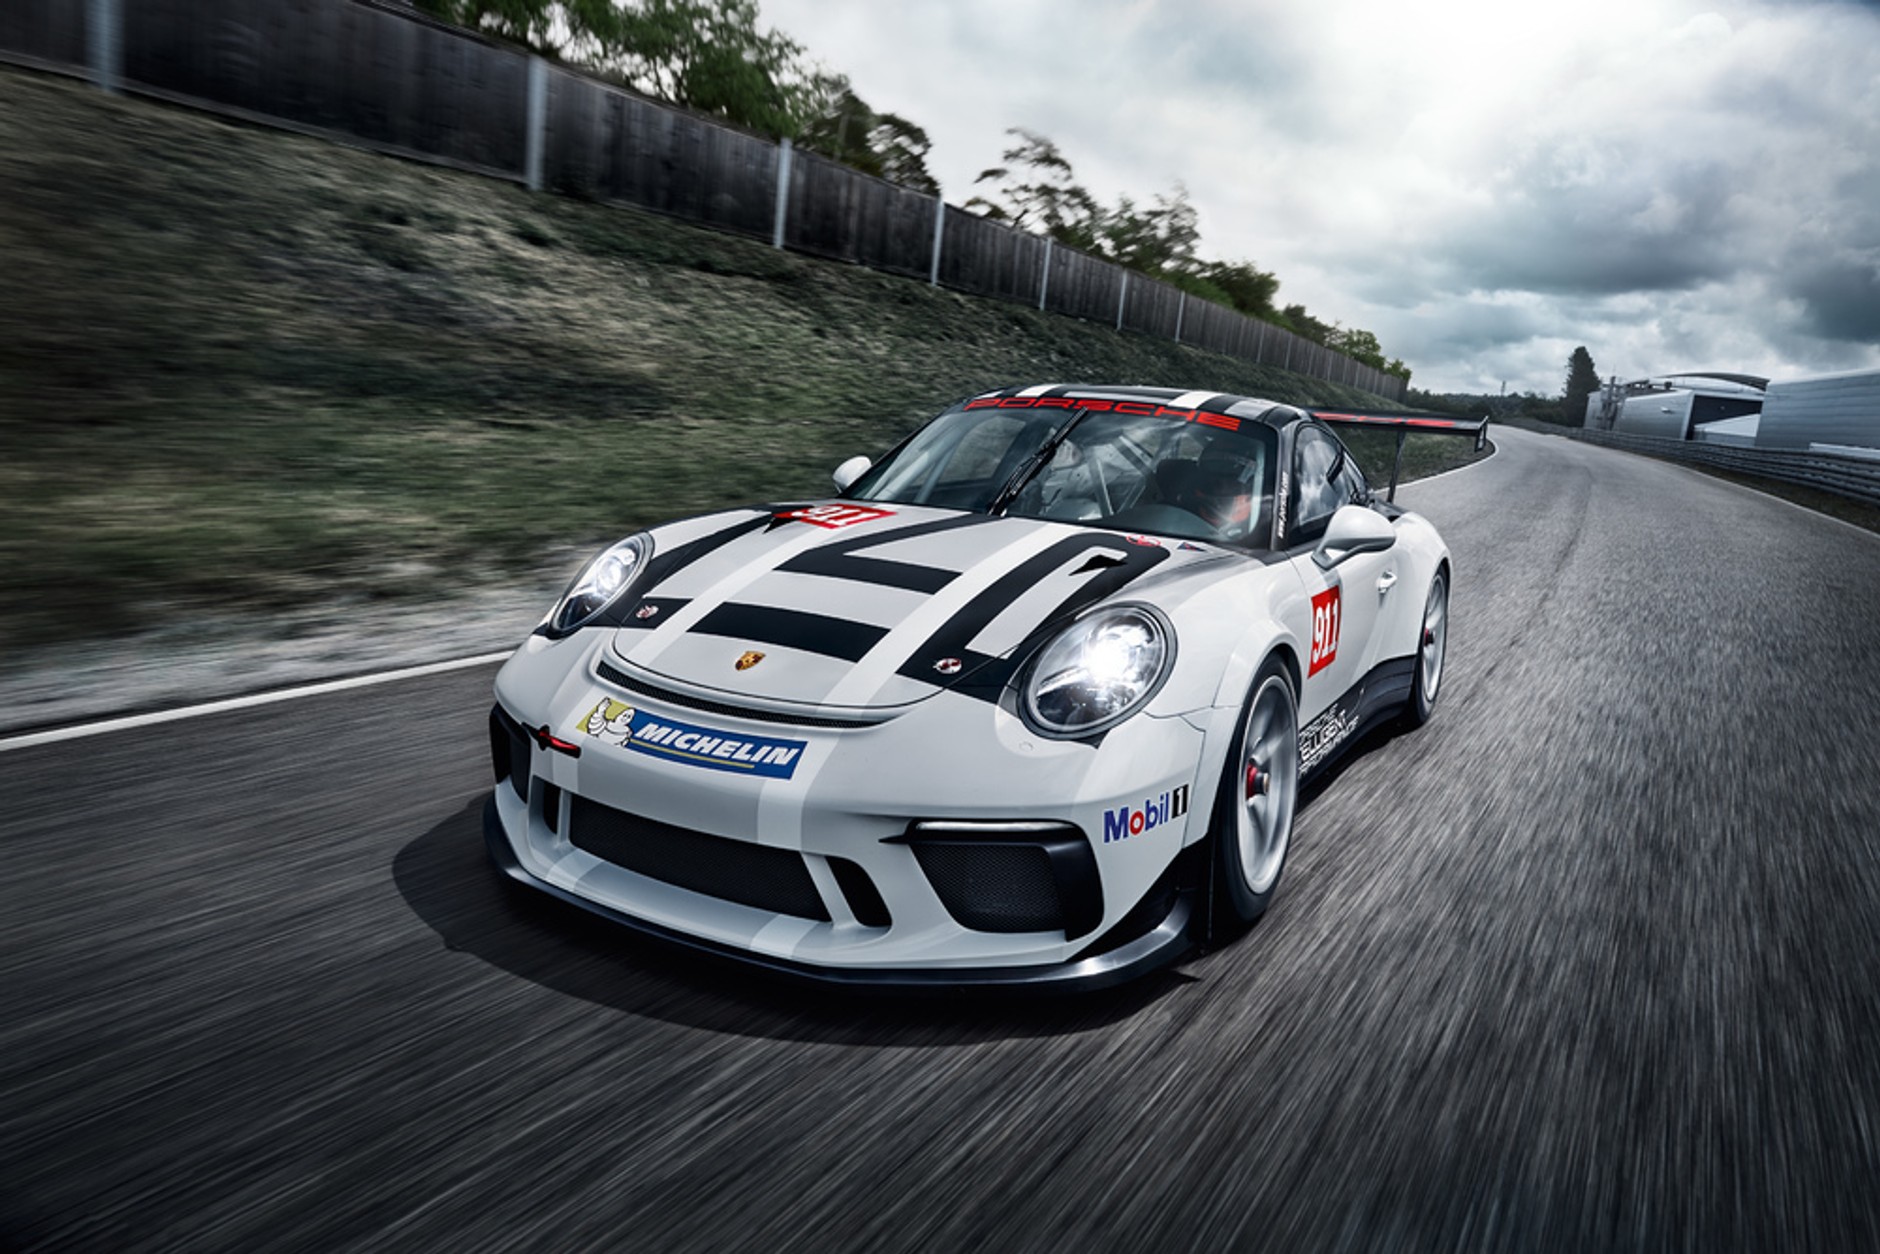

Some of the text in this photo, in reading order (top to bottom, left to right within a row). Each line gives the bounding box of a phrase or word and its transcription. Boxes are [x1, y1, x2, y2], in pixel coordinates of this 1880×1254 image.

[964, 397, 1242, 432] PORSCHE
[791, 505, 881, 527] 911
[1313, 598, 1338, 664] 911
[635, 722, 800, 767] MICHELIN
[1103, 792, 1169, 844] Mobil
